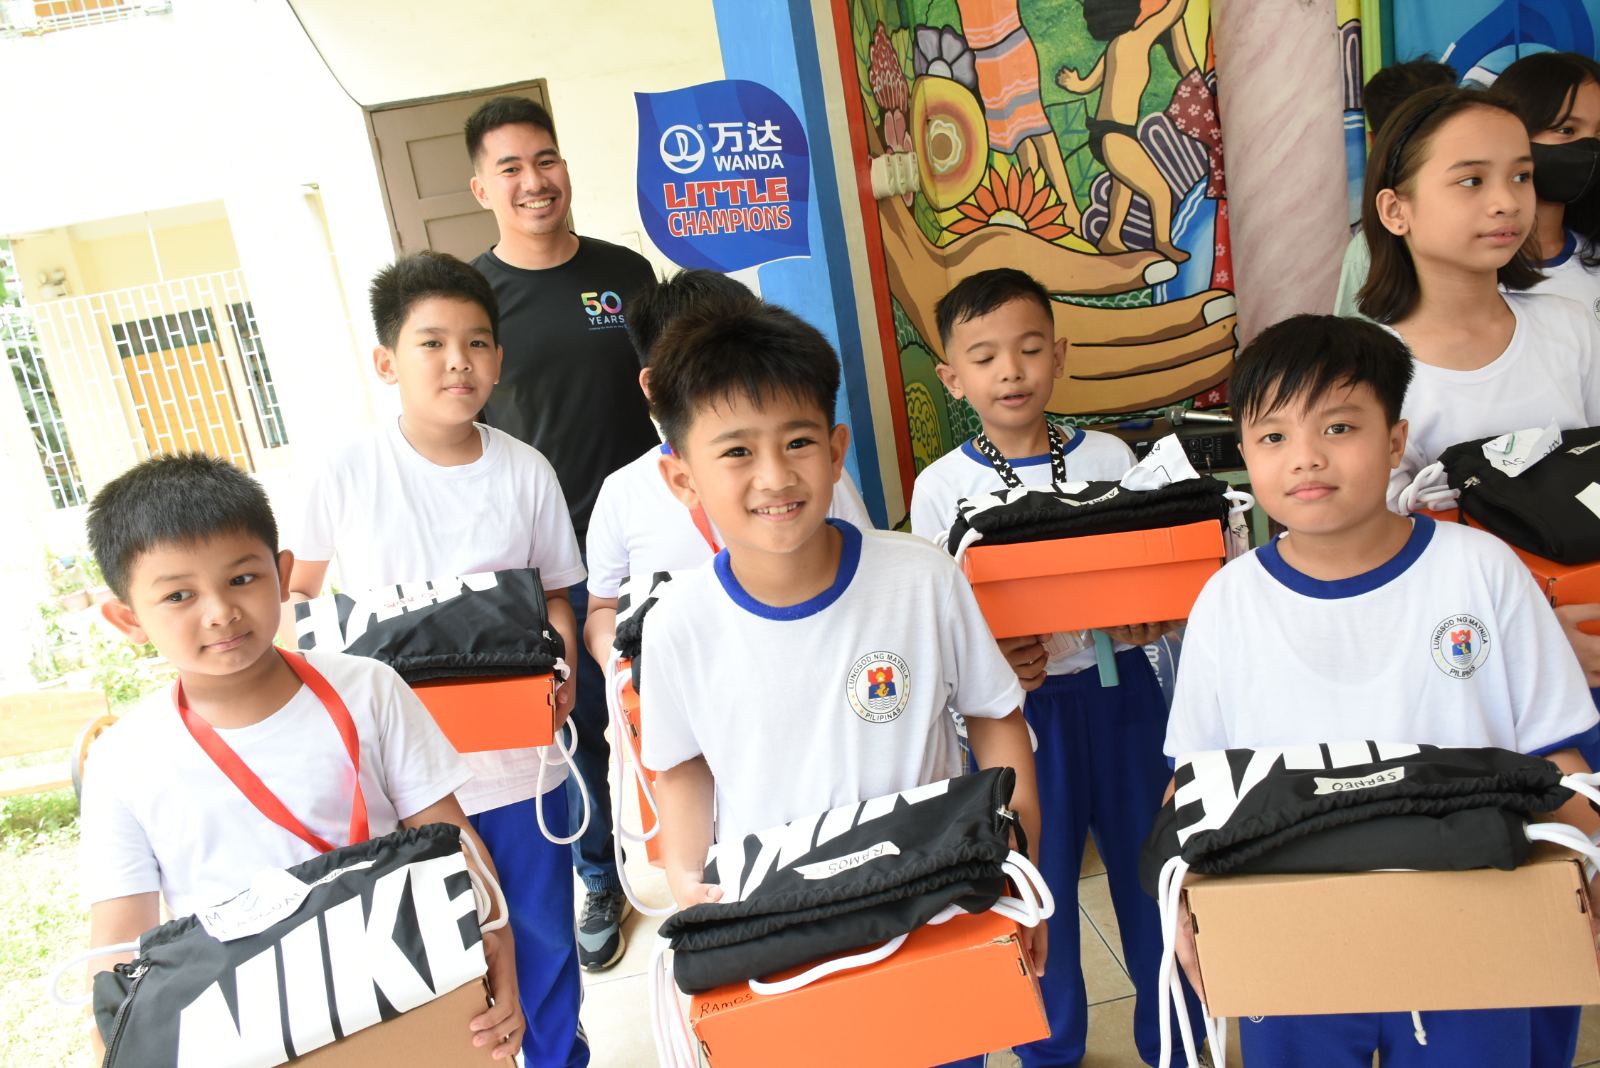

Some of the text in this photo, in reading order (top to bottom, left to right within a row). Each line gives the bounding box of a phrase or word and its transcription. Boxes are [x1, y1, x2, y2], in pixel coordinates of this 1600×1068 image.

[708, 120, 783, 153] 万达
[713, 153, 784, 172] WANDA
[663, 176, 790, 209] LITTLE
[667, 205, 792, 238] CHAMPIONS
[581, 290, 622, 316] 50
[588, 314, 625, 325] YEARS
[1433, 619, 1455, 650] LUNGSOD
[1469, 618, 1489, 645] MAYNILA
[848, 656, 872, 690] LUNGSOD
[887, 654, 909, 680] MAYNILA
[864, 708, 901, 721] PILIPINAS
[176, 851, 489, 1068] NIKE
